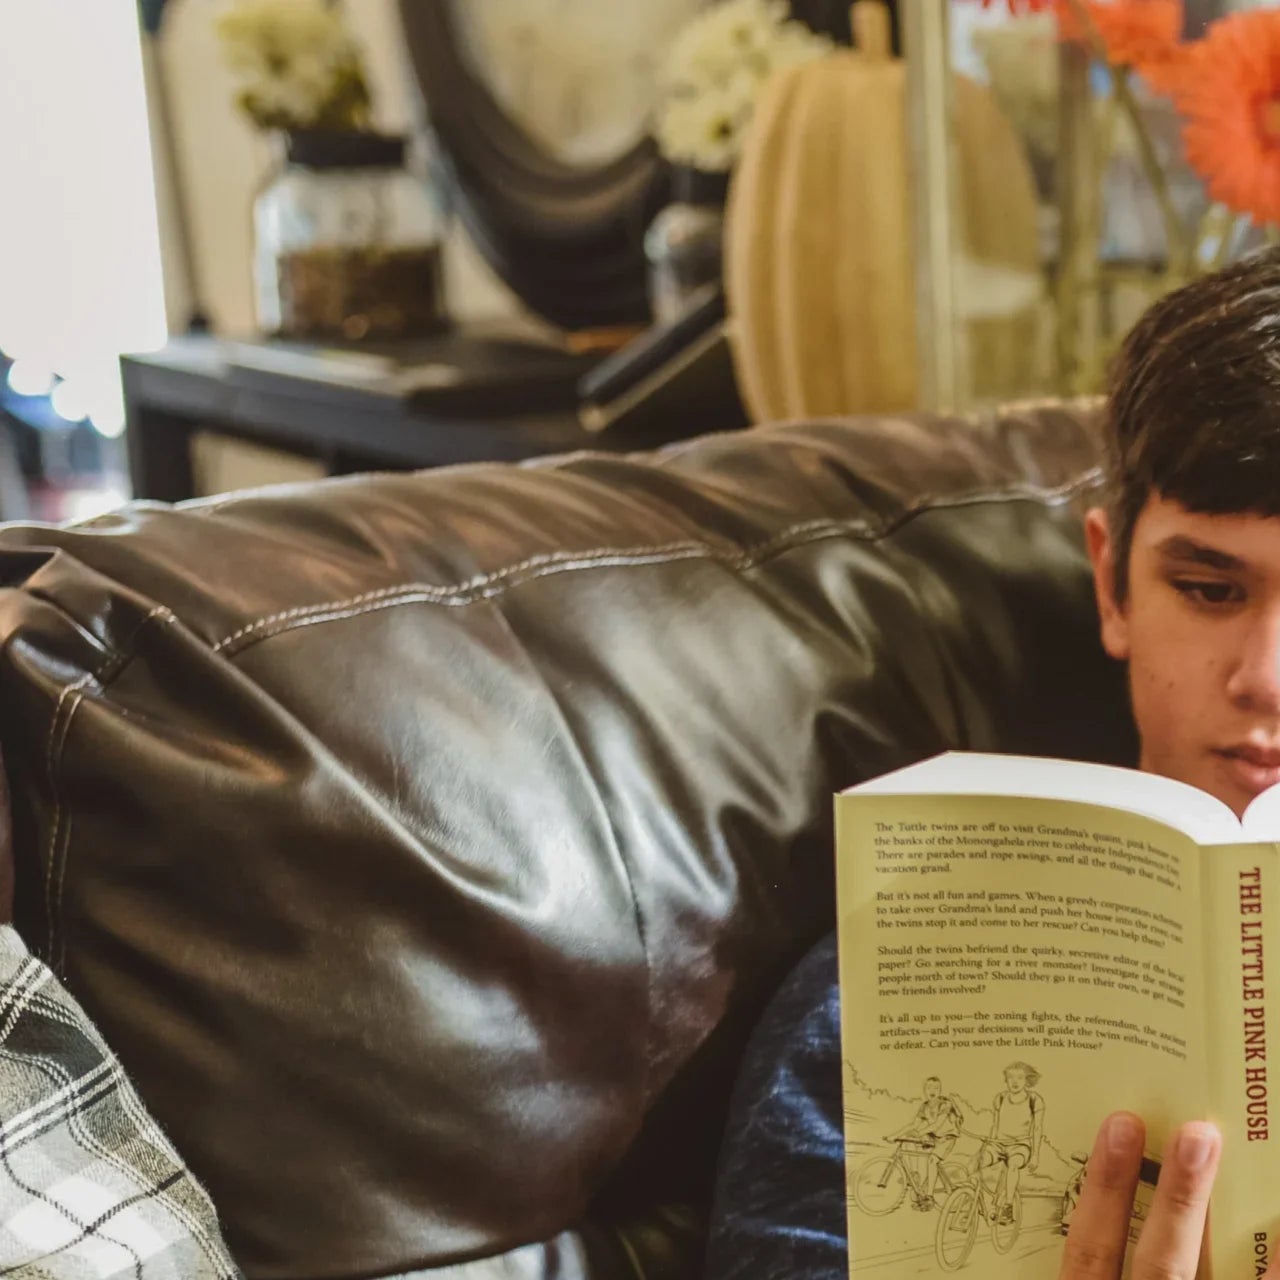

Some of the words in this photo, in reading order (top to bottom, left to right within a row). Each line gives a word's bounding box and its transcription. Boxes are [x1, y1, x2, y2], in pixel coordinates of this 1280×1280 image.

[875, 823, 893, 832] The
[899, 823, 926, 832] Tuttle
[932, 823, 958, 831] twins
[963, 824, 978, 832] are
[982, 822, 995, 832] off
[1000, 824, 1009, 832] to
[1013, 824, 1033, 833] visit
[875, 836, 890, 846] the
[893, 836, 922, 845] banks
[926, 835, 935, 845] of
[938, 835, 954, 845] the
[956, 836, 1024, 848] Monongahela
[1027, 838, 1049, 848] river
[1052, 840, 1062, 848] to
[1065, 841, 1105, 855] celebrate
[876, 863, 917, 873] vacation
[921, 862, 952, 875] grand.
[877, 850, 903, 860] There
[907, 852, 923, 860] are
[926, 850, 964, 861] parades
[969, 850, 987, 860] and
[991, 852, 1013, 861] rope
[1017, 852, 1053, 862] swings,
[1057, 854, 1074, 864] and
[1078, 855, 1088, 866] all
[1092, 857, 1106, 868] the
[1109, 861, 1135, 876] things
[877, 892, 893, 901] But
[897, 891, 910, 901] it's
[914, 892, 928, 900] not
[933, 890, 944, 900] all
[948, 890, 963, 900] fun
[967, 890, 986, 900] and
[988, 892, 1020, 902] games.
[1025, 891, 1055, 902] When
[1066, 896, 1097, 907] greedy
[1239, 867, 1261, 916] THE
[877, 906, 887, 915] to
[890, 905, 911, 914] take
[914, 906, 935, 914] over
[938, 904, 991, 914] Grandma's
[995, 904, 1016, 914] land
[1019, 905, 1037, 914] and
[1041, 906, 1063, 917] push
[1067, 908, 1082, 917] her
[1086, 909, 1113, 922] house
[1115, 915, 1132, 926] into
[1135, 919, 1148, 929] the
[877, 919, 893, 929] the
[896, 918, 923, 928] twins
[925, 918, 946, 929] stop
[949, 917, 956, 927] it
[960, 917, 977, 927] and
[981, 919, 1007, 927] come
[1011, 918, 1020, 928] to
[1023, 917, 1039, 928] her
[1042, 921, 1078, 931] rescue?
[1080, 922, 1099, 933] Can
[1102, 927, 1118, 937] you
[1122, 929, 1140, 943] help
[878, 946, 912, 956] Should
[917, 945, 932, 955] the
[936, 945, 963, 954] twins
[966, 944, 1008, 954] befriend
[1012, 944, 1027, 954] the
[1032, 946, 1065, 958] quirky,
[1069, 949, 1109, 961] secretive
[1113, 954, 1139, 967] editor
[1240, 920, 1264, 1000] LITTLE
[878, 960, 911, 971] paper?
[916, 959, 931, 968] Go
[935, 958, 982, 969] searching
[987, 957, 1001, 967] for
[1015, 958, 1038, 968] river
[1043, 961, 1087, 971] monster?
[1092, 963, 1140, 980] Investigate
[1143, 973, 1155, 984] the
[879, 973, 911, 985] people
[915, 972, 942, 982] north
[945, 971, 955, 981] of
[959, 971, 988, 981] town?
[991, 970, 1026, 981] Should
[1029, 972, 1050, 983] they
[1053, 975, 1065, 984] go
[1069, 975, 1075, 983] it
[1093, 977, 1114, 988] their
[1118, 983, 1138, 994] own,
[879, 987, 899, 997] new
[902, 985, 936, 996] friends
[939, 984, 986, 994] involved?
[880, 1014, 893, 1023] It's
[898, 1013, 909, 1023] all
[914, 1015, 926, 1024] up
[930, 1013, 940, 1021] to
[994, 1011, 1027, 1022] zoning
[1032, 1011, 1061, 1023] fights,
[1066, 1013, 1080, 1023] the
[1143, 1025, 1156, 1036] the
[952, 1026, 974, 1037] your
[978, 1024, 1023, 1034] decisions
[1027, 1024, 1044, 1034] will
[1048, 1025, 1074, 1036] guide
[1078, 1026, 1092, 1037] the
[1096, 1029, 1120, 1040] twins
[1124, 1034, 1148, 1047] either
[1243, 1006, 1265, 1062] PINK
[880, 1042, 891, 1051] or
[894, 1040, 925, 1050] defeat.
[929, 1039, 949, 1048] Can
[952, 1040, 969, 1050] you
[973, 1039, 993, 1047] save
[996, 1037, 1011, 1047] the
[1014, 1037, 1040, 1047] Little
[1043, 1038, 1065, 1048] Pink
[1244, 1064, 1268, 1142] HOUSE
